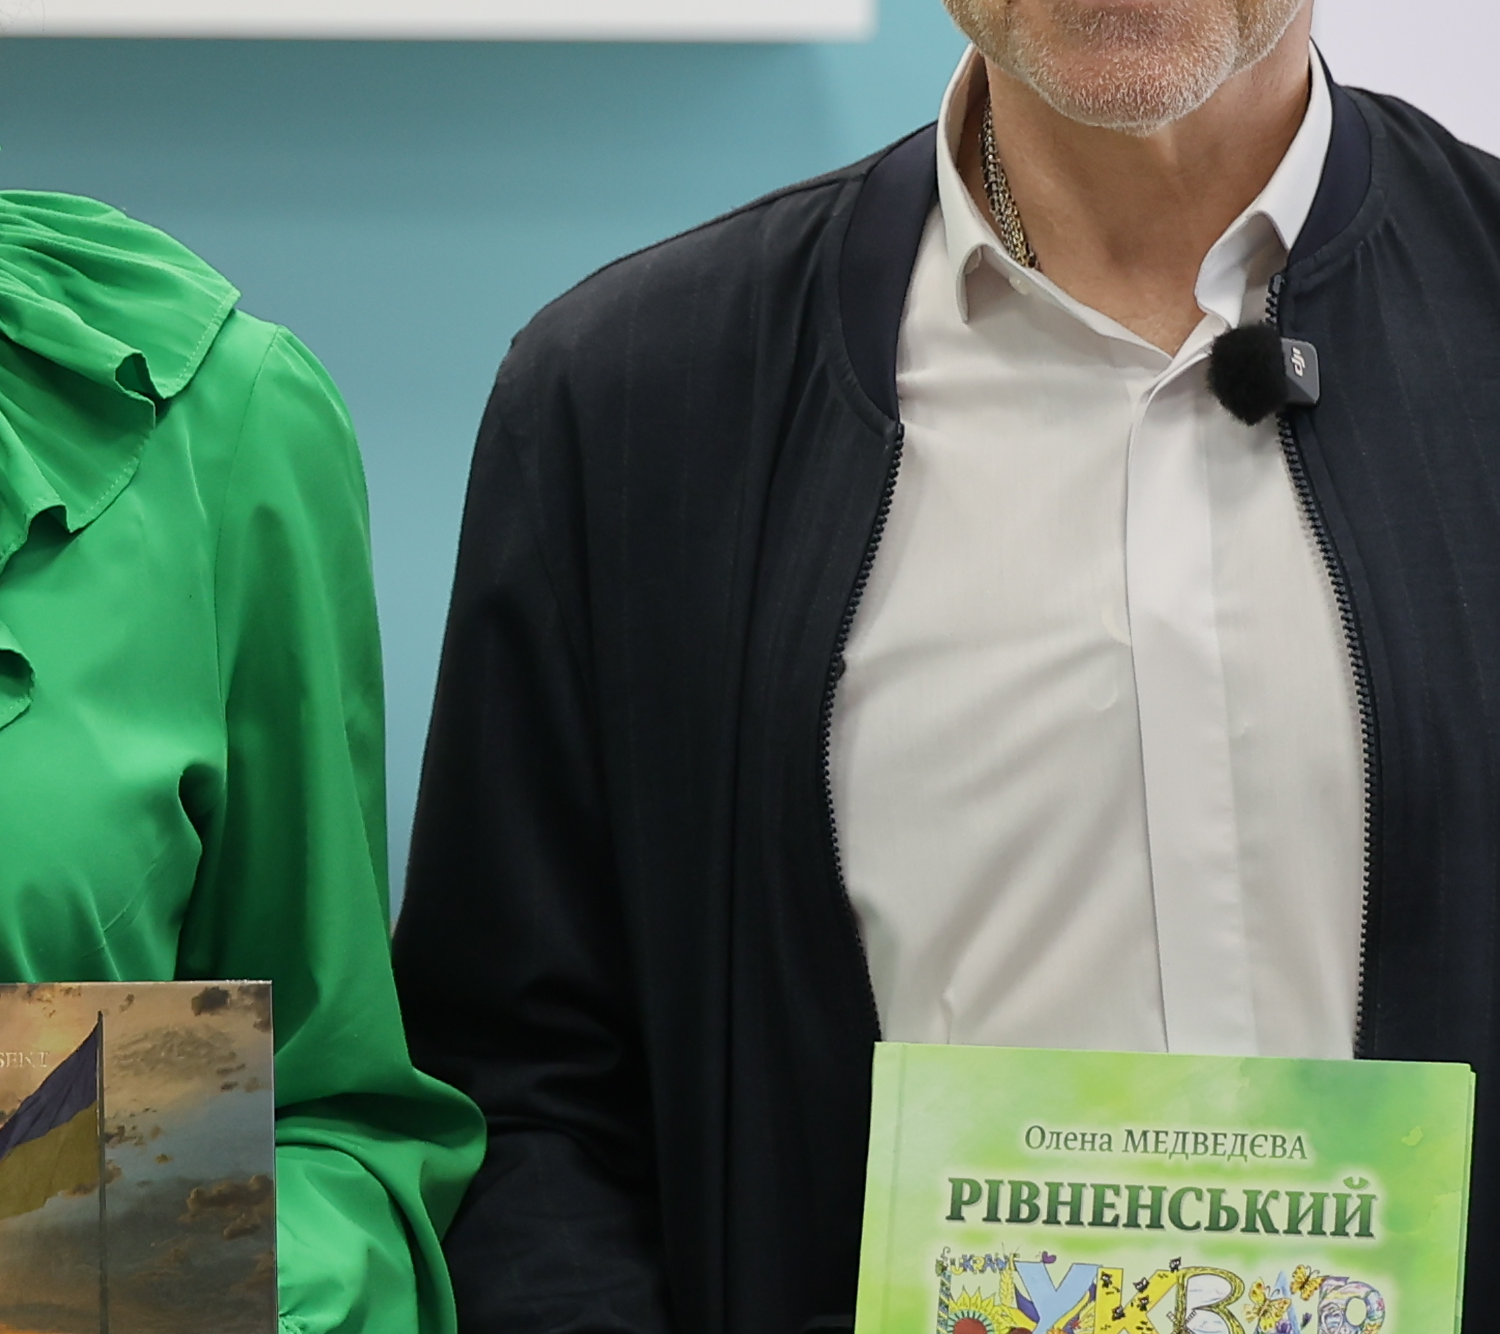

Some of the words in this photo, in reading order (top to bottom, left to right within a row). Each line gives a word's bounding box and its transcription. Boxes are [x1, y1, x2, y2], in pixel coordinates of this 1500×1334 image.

[1291, 347, 1305, 377] dji
[1024, 1124, 1114, 1153] Олена
[1122, 1128, 1308, 1162] МЕДВЕДЄВА
[945, 1175, 1378, 1239] РІВНЕНСЬКИЙ
